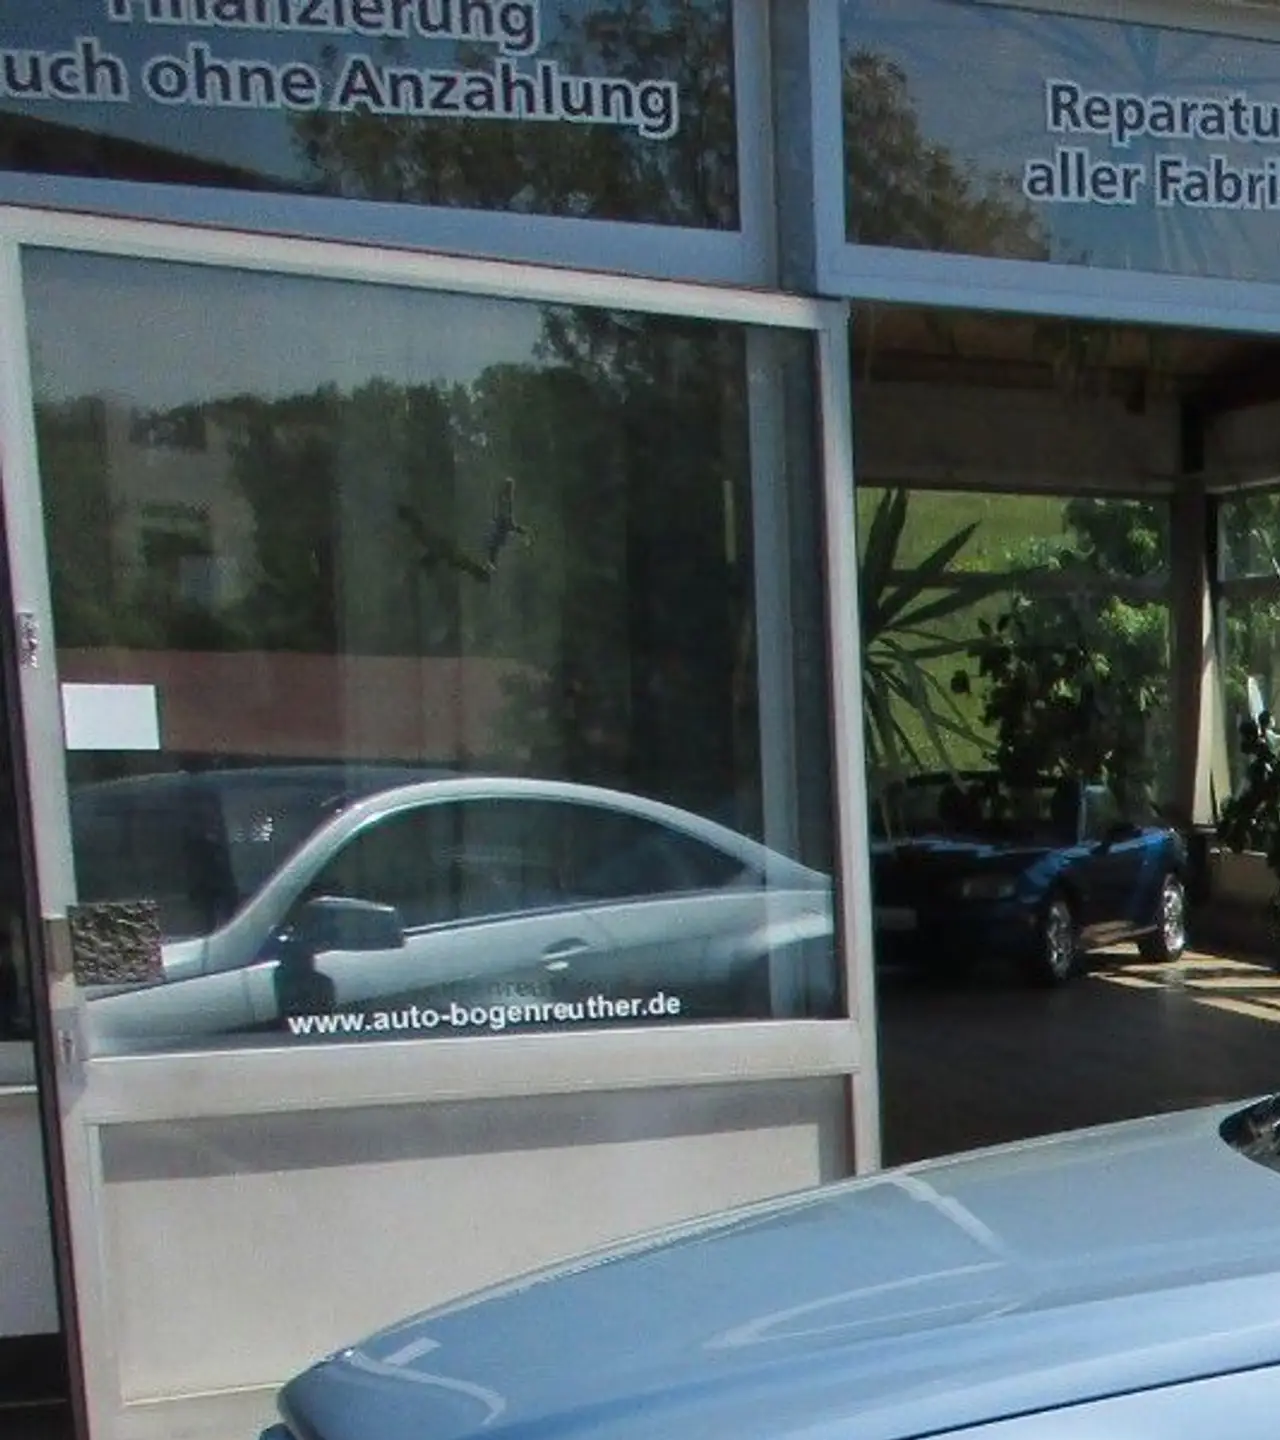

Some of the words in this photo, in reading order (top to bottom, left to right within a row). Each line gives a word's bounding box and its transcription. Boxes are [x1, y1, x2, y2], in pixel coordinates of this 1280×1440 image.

[146, 43, 320, 108] ohne
[334, 55, 677, 137] Anzahlung
[1026, 148, 1143, 202] aller
[288, 990, 681, 1036] www.auto-bogenreuther.de
